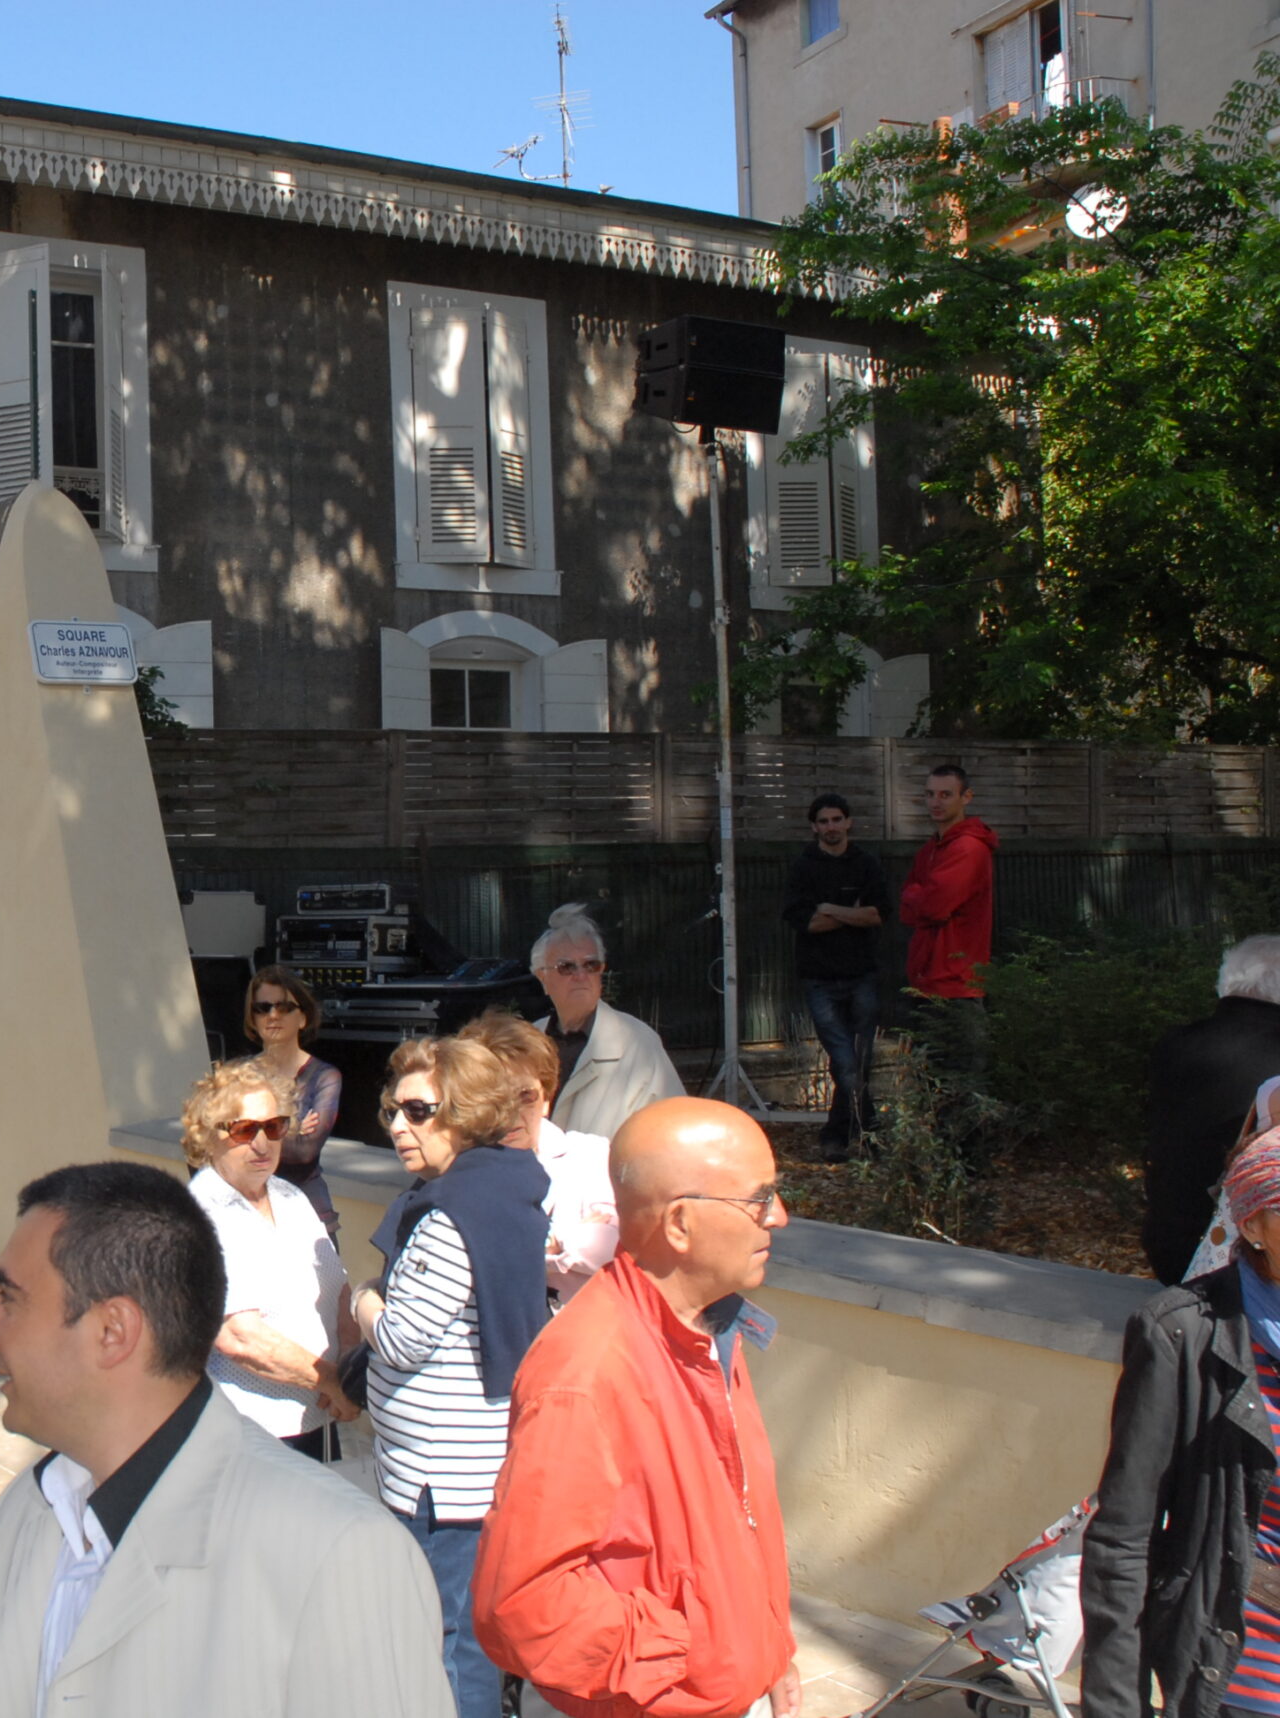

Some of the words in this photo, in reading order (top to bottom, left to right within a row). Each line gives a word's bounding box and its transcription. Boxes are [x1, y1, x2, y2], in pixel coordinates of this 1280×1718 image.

[57, 629, 107, 642] SQUARE
[40, 644, 76, 657] Charles
[78, 646, 129, 659] AZNAVOUR
